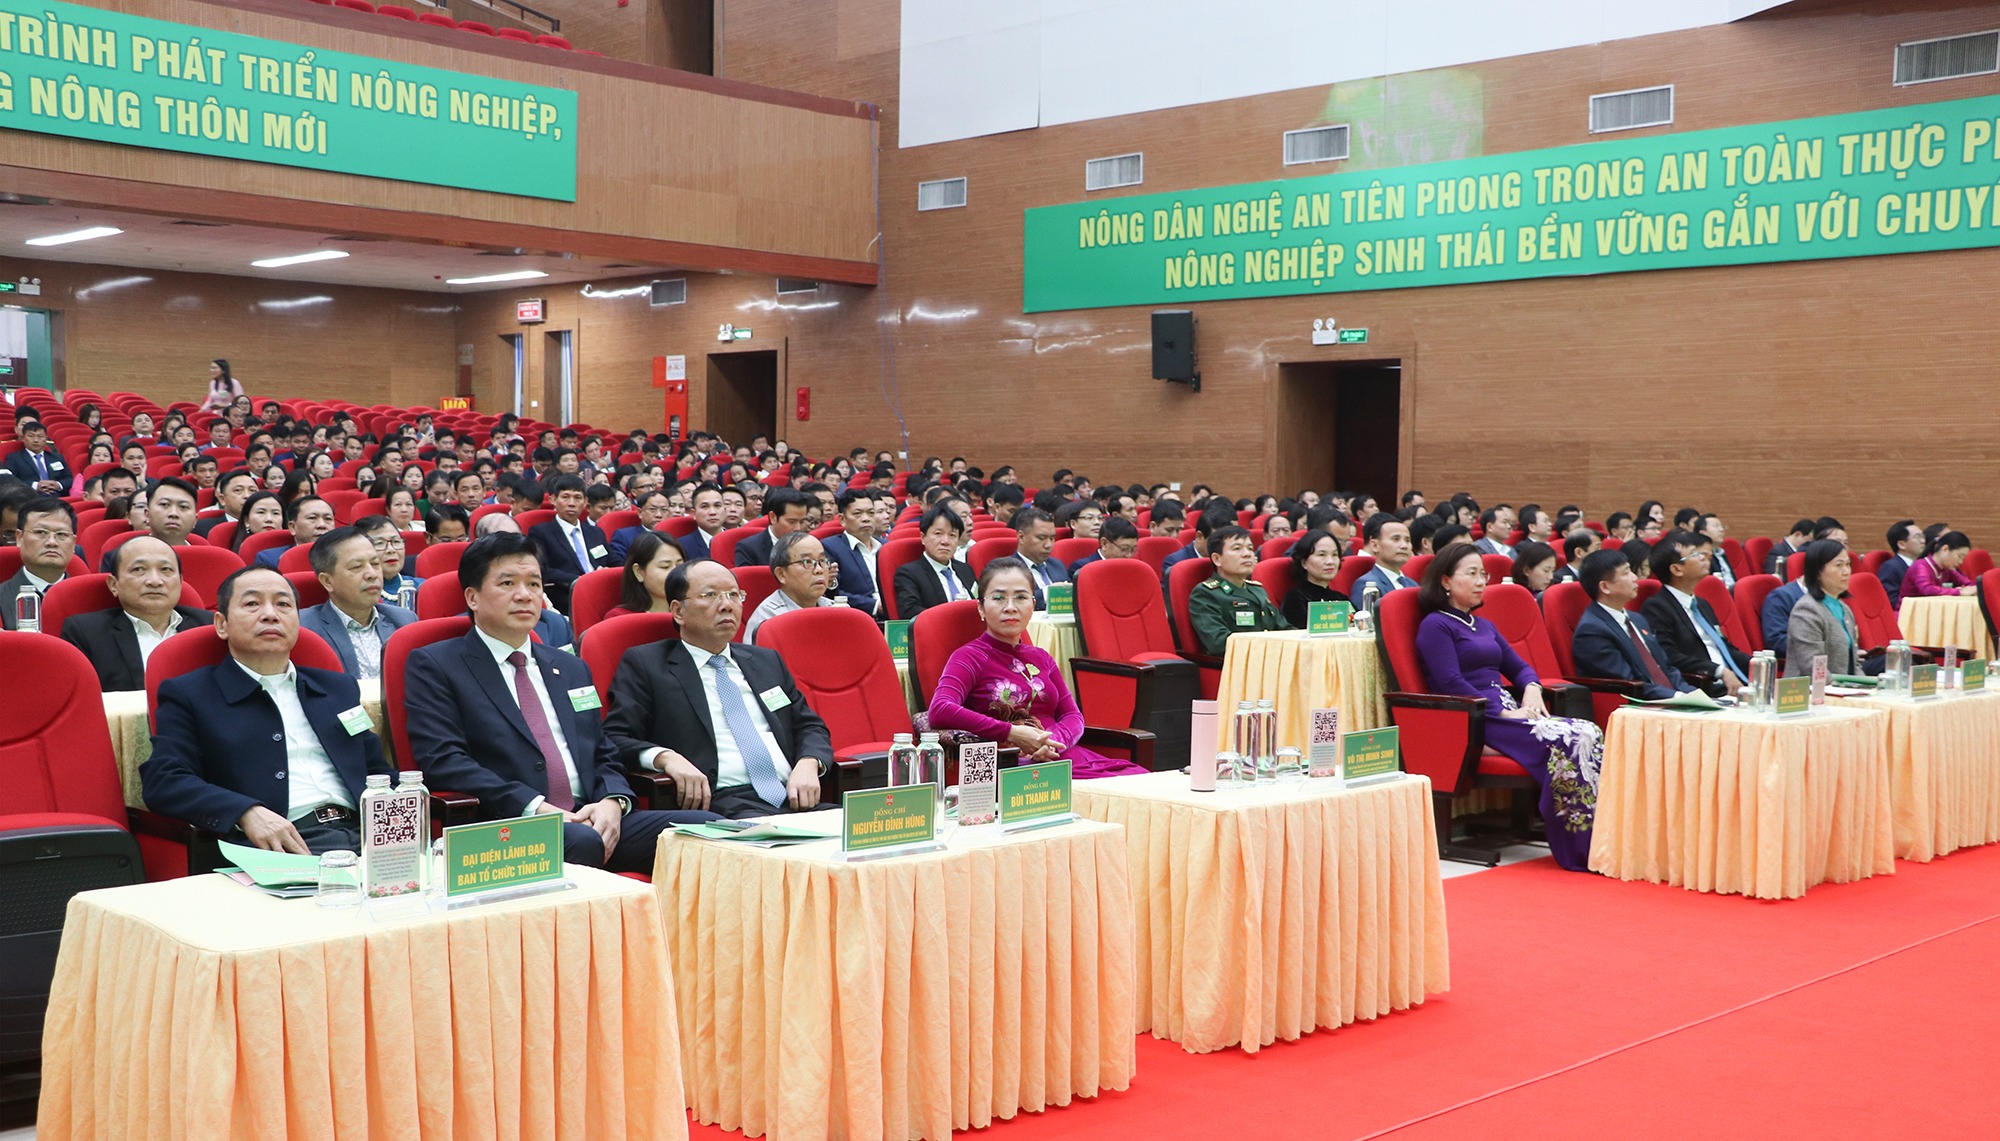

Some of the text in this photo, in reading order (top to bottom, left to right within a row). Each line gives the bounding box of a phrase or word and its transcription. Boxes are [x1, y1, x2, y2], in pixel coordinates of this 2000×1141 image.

[0, 11, 562, 141] TRÌNH PHÁT TRIỂN NÔNG NGHIỆP,
[30, 74, 141, 129] NÔNG
[154, 95, 249, 144] THÔN
[262, 111, 327, 155] MỚI
[1079, 209, 1144, 248] NÔNG
[1153, 201, 1204, 242] DÂN
[1213, 191, 1283, 238] NGHỆ
[1292, 193, 1330, 229] AN
[1341, 180, 1405, 224] TIÊN
[1416, 171, 1521, 217] PHONG
[1533, 157, 1645, 205] TRONG
[1656, 151, 1708, 194] AN
[1721, 134, 1823, 187] TOÀN
[1838, 122, 1946, 179] THỰC
[1164, 249, 1235, 289] NÔNG
[1244, 238, 1344, 286] NGHIỆP
[1355, 237, 1425, 276] SINH
[1436, 222, 1505, 269] THÁI
[1517, 212, 1583, 263] BỀN
[1595, 209, 1689, 257] VỮNG
[1702, 193, 1780, 249] GẮN
[1795, 191, 1860, 242] VỚI
[873, 805, 906, 817] ĐỒNG CHÍ
[1010, 793, 1024, 808] BÙI
[1025, 790, 1049, 805] THANH
[1050, 788, 1061, 801] AN
[852, 813, 926, 836] NGUYỄN ĐÌNH HÙNG
[462, 842, 546, 868] ĐẠI DIỆN LÃNH ĐẠO
[457, 857, 551, 886] BAN TỔ CHỨC TỈNH ỦY
